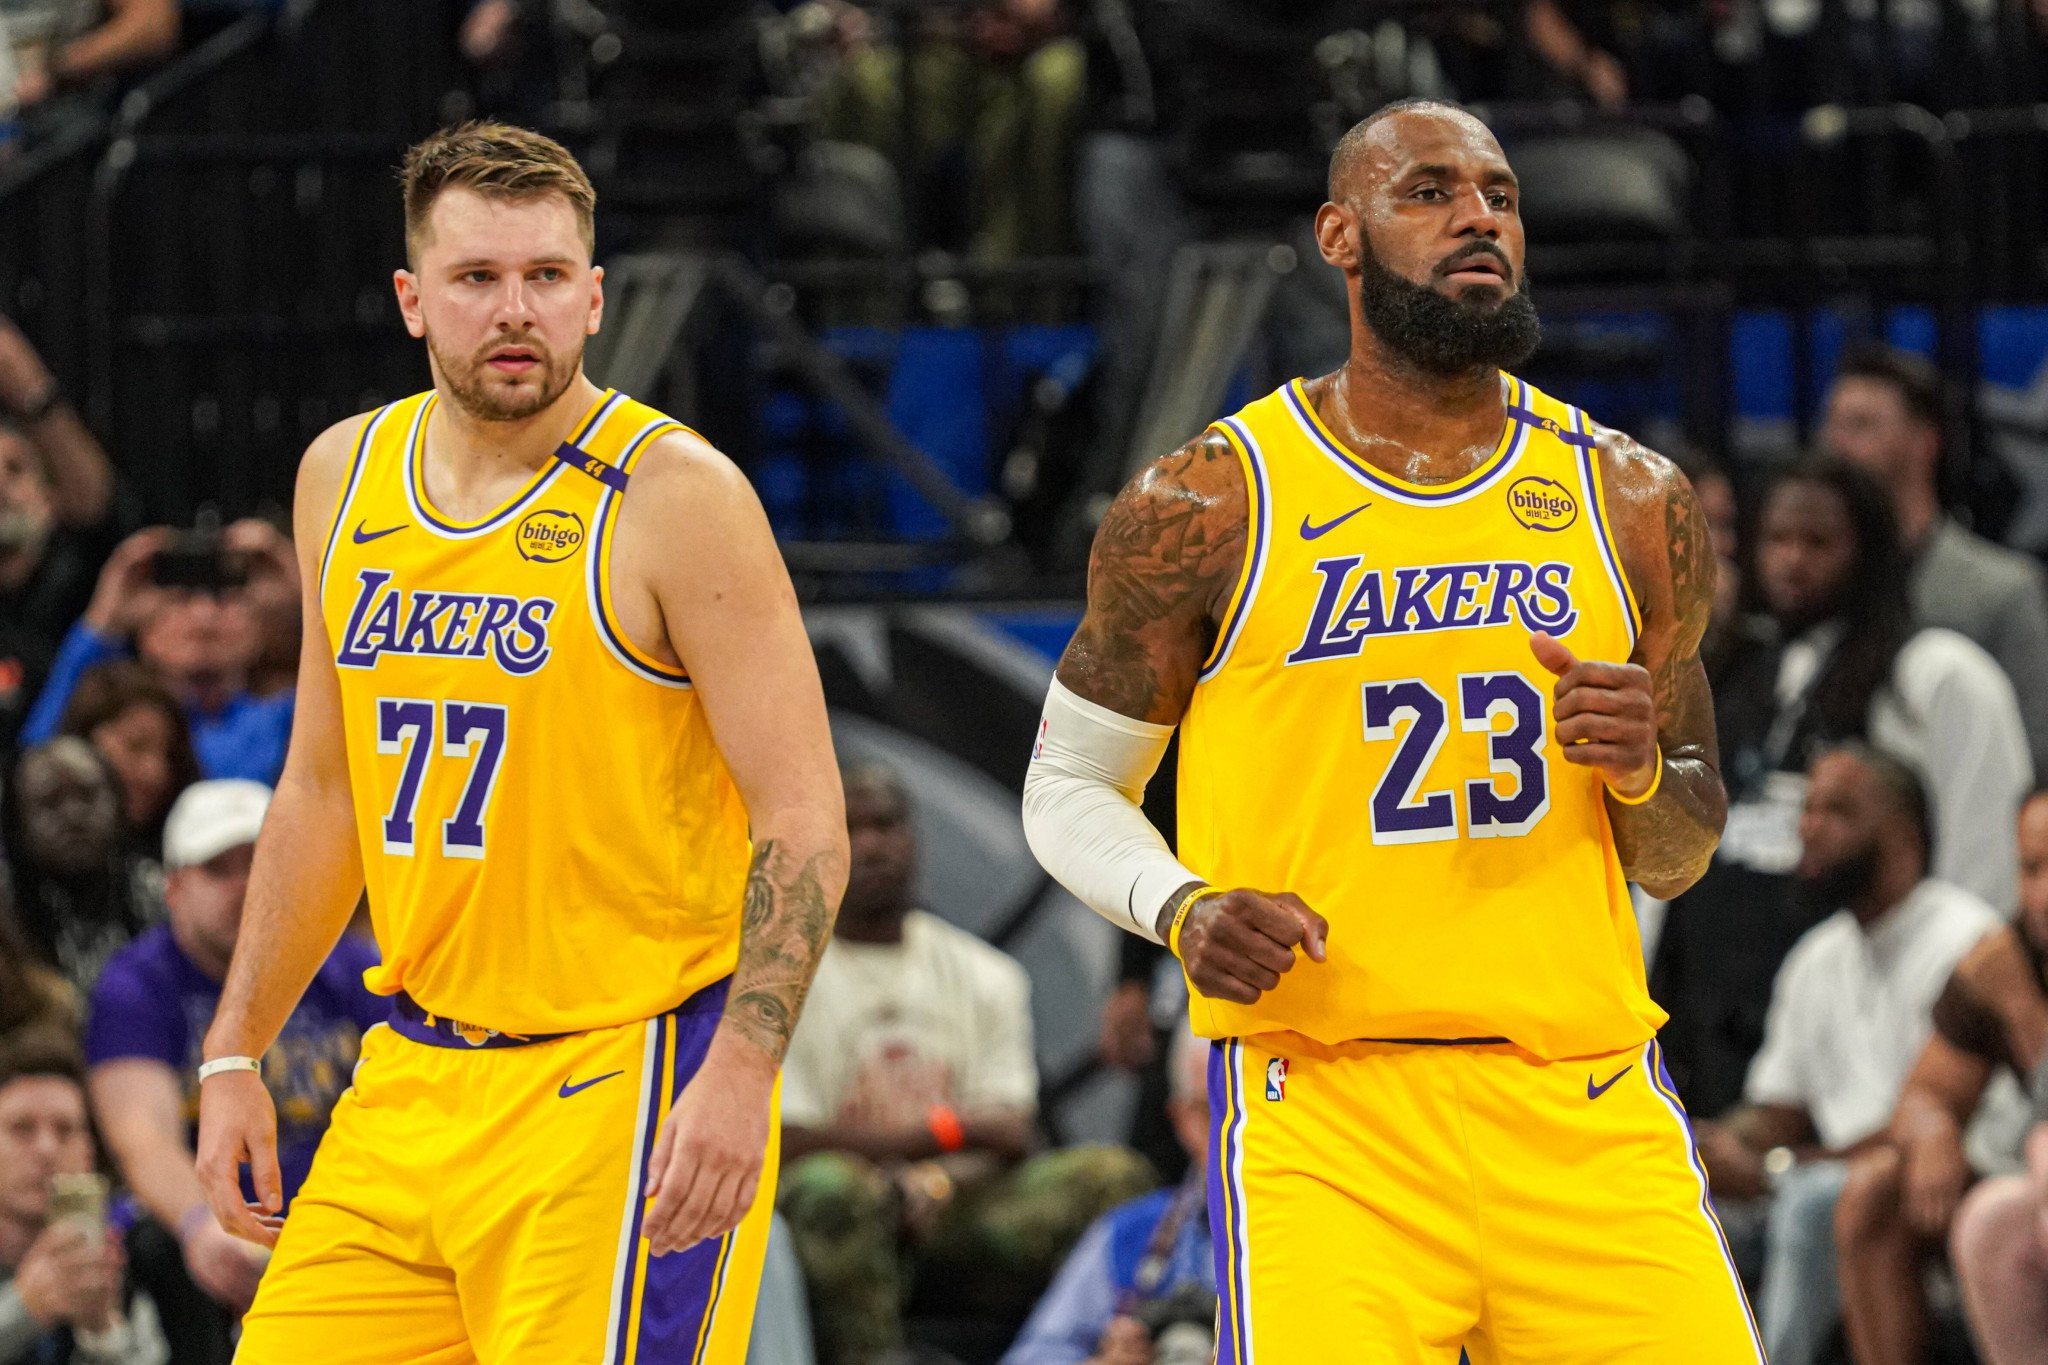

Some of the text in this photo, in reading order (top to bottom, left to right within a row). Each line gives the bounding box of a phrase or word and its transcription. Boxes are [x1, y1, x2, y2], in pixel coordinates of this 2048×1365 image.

[584, 459, 606, 478] 44
[523, 522, 580, 548] bibigo
[1513, 490, 1572, 517] bibigo
[1526, 509, 1550, 520] 비비고
[336, 568, 556, 677] LAKERS
[1284, 553, 1579, 667] LAKERS
[376, 697, 508, 860] 77
[1360, 670, 1551, 846] 23
